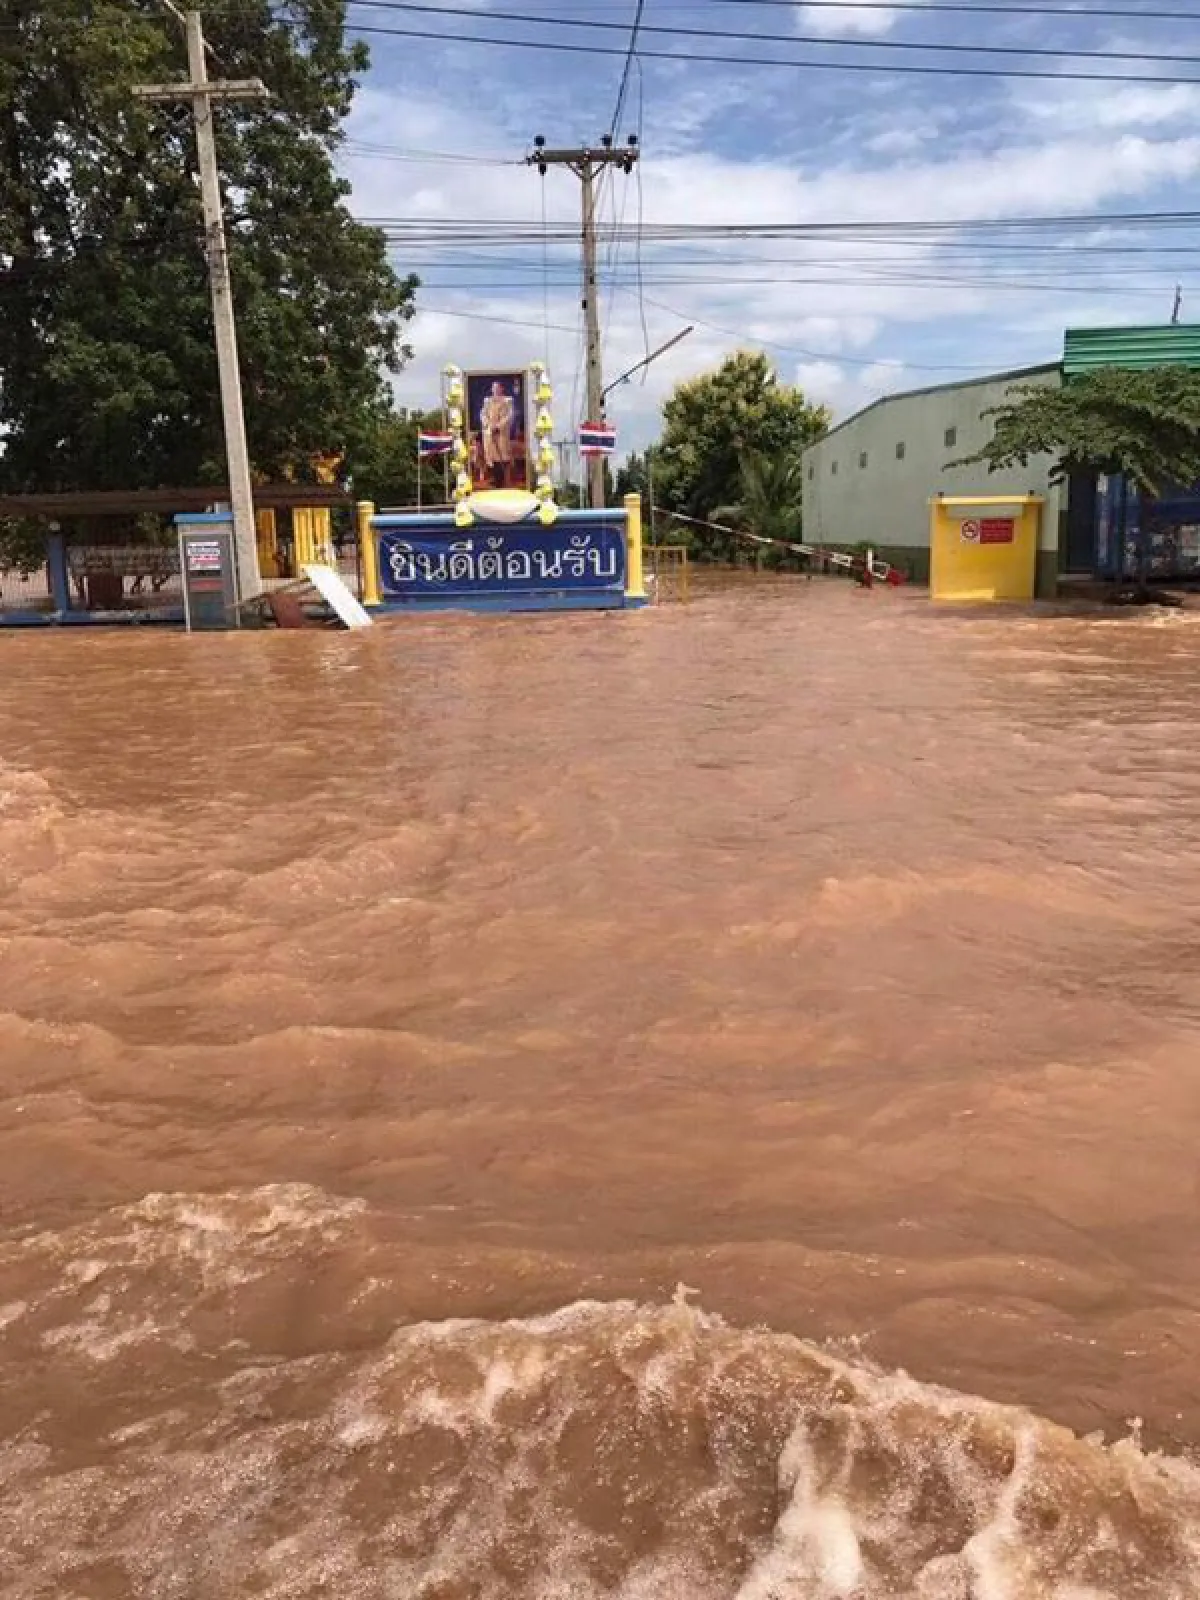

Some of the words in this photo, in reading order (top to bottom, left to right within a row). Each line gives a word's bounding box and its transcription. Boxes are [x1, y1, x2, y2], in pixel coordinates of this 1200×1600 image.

[389, 535, 617, 582] ยินดีต้อนรับ
